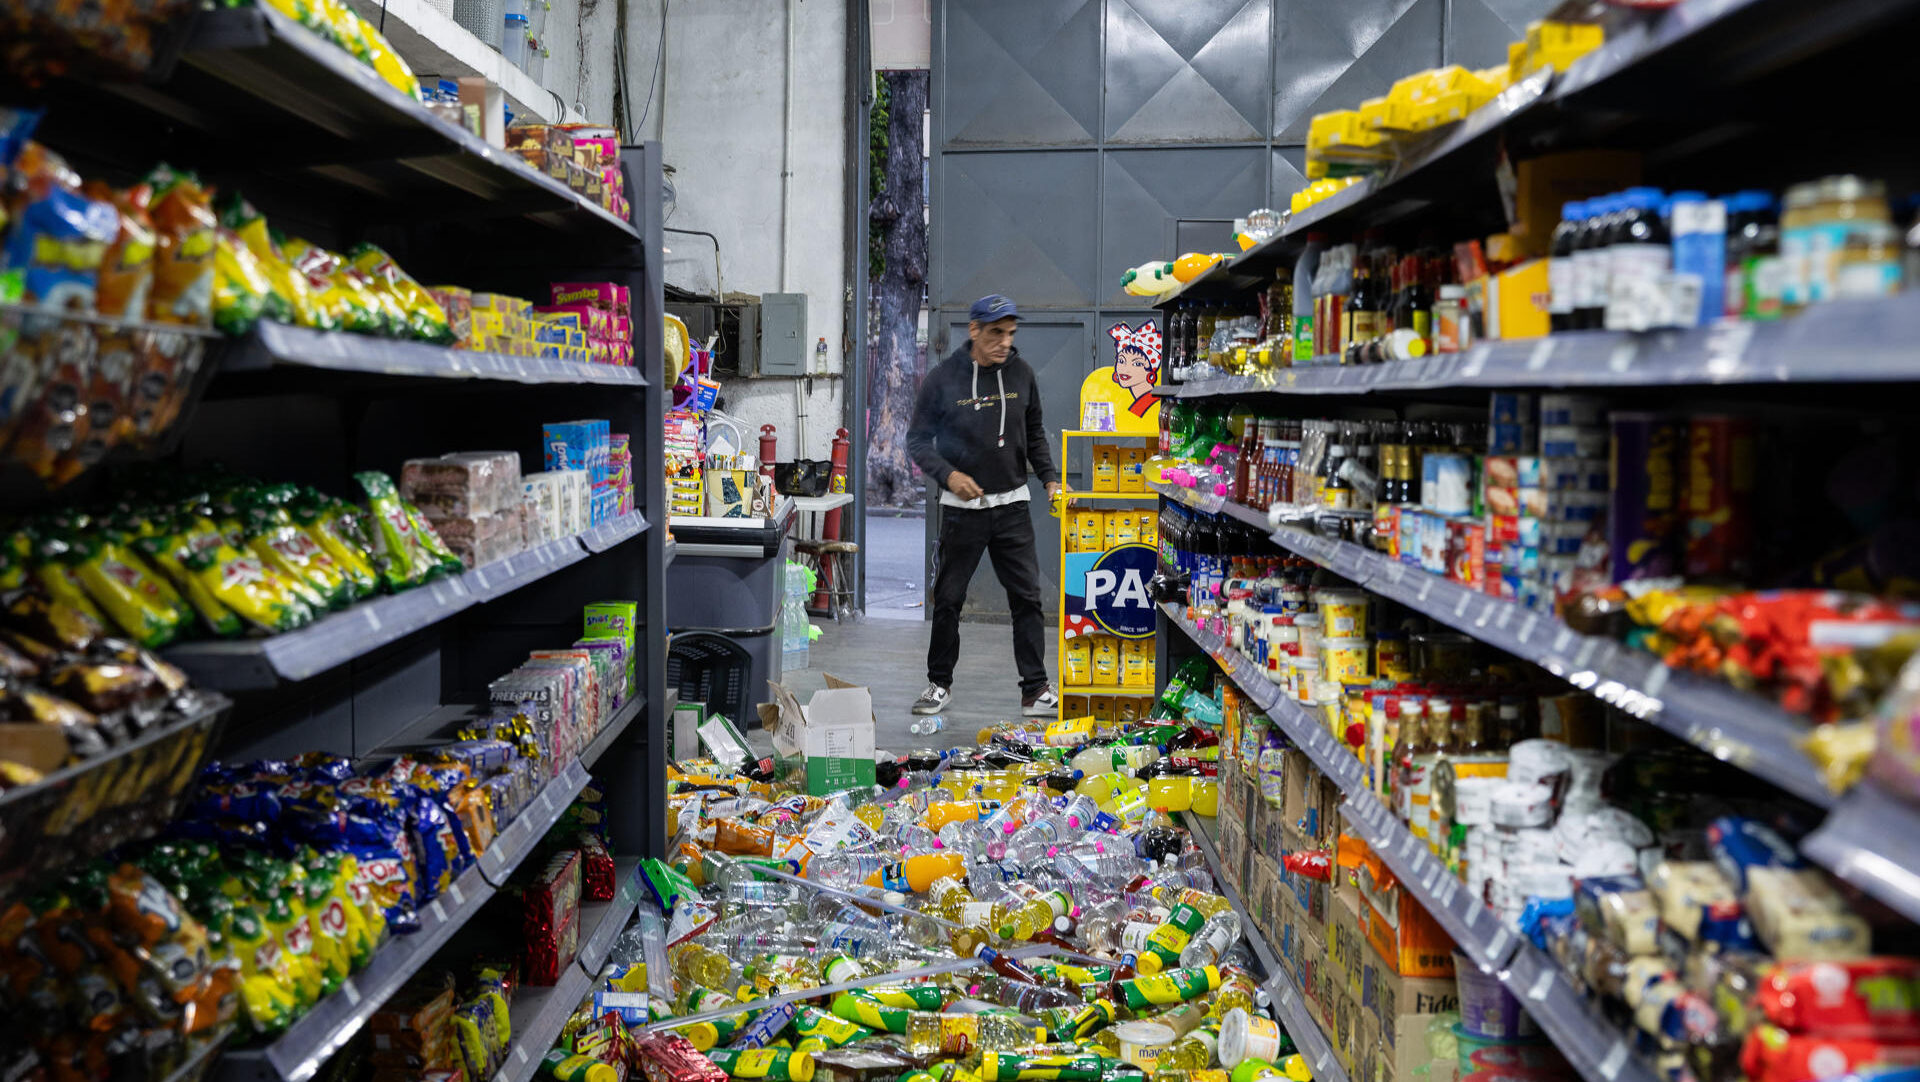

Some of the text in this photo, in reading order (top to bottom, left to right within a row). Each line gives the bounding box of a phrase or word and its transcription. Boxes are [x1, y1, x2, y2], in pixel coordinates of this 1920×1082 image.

[556, 288, 599, 305] Samba
[1084, 568, 1157, 611] P.A.
[1416, 992, 1459, 1014] Fide
